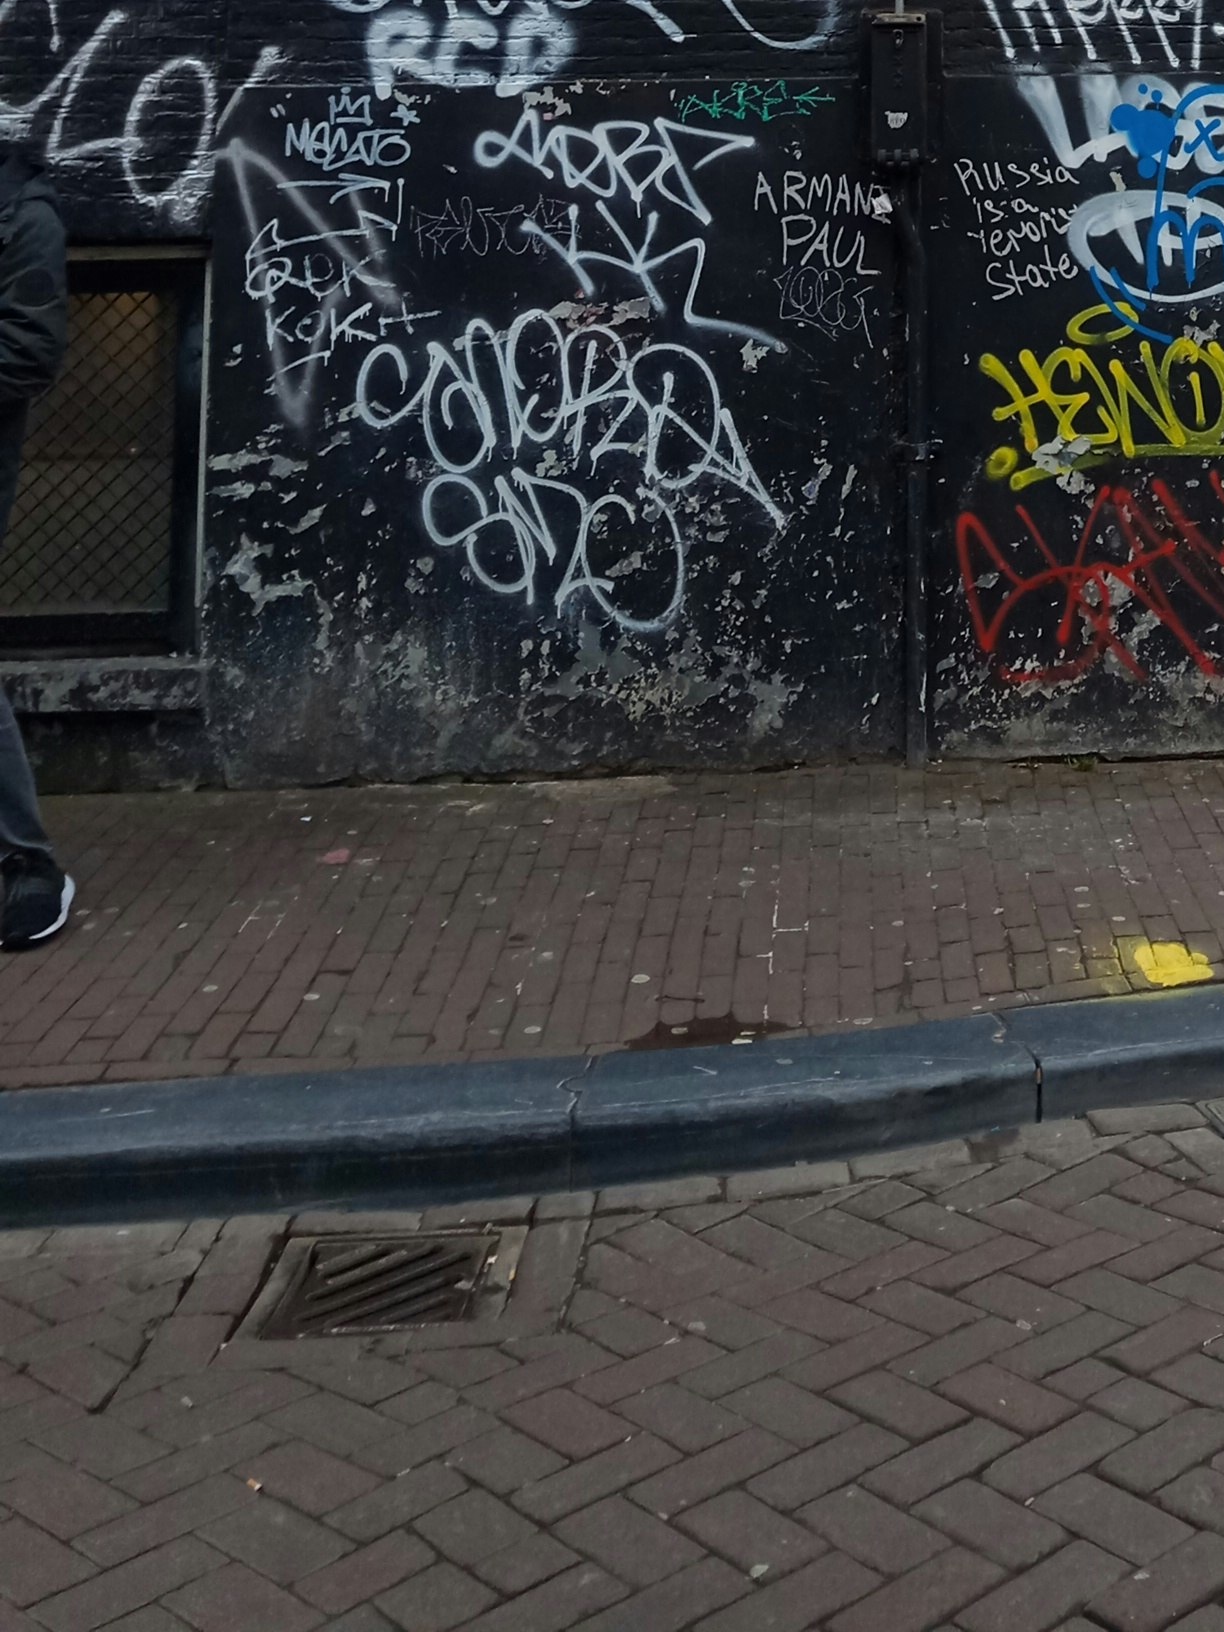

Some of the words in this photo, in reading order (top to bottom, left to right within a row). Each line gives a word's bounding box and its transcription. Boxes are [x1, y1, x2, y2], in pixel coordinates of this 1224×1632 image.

[953, 157, 1080, 196] Russia
[781, 214, 881, 274] PAUL
[986, 244, 1079, 301] State
